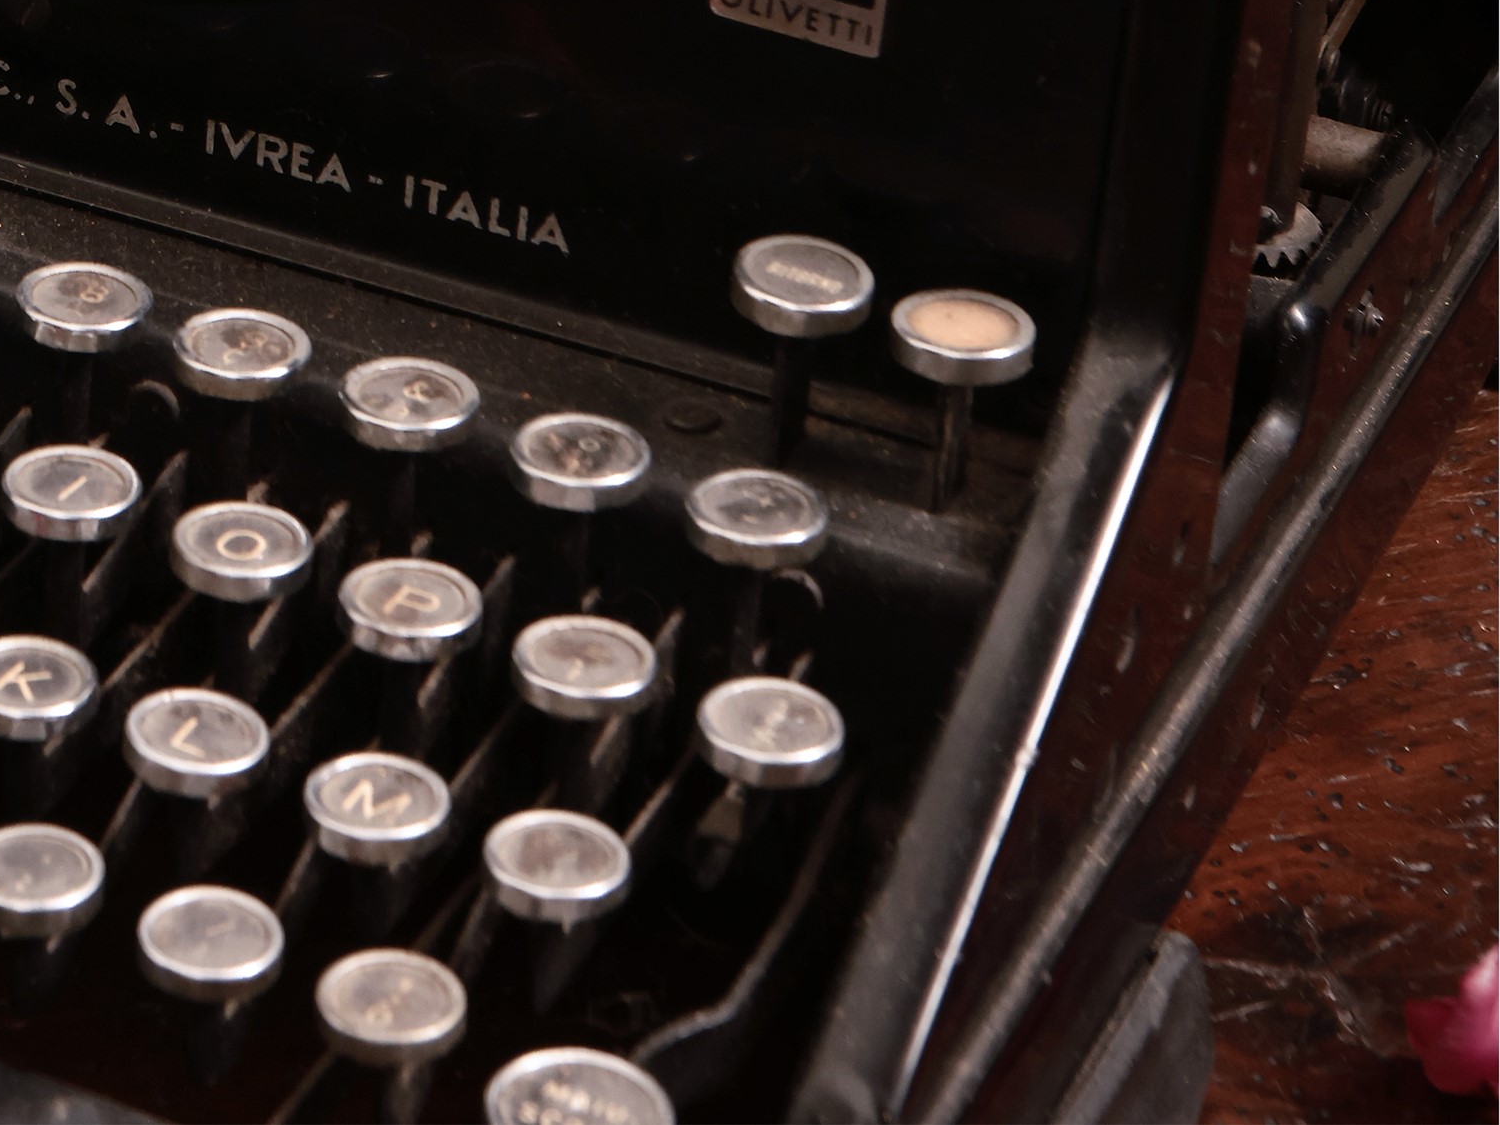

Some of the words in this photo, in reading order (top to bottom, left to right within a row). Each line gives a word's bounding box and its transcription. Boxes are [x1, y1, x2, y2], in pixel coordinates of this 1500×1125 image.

[205, 119, 351, 192] IVREA
[404, 175, 571, 257] ITALIA
[56, 475, 88, 503] I
[383, 585, 442, 615] P
[169, 716, 207, 758] L
[342, 779, 413, 825] M
